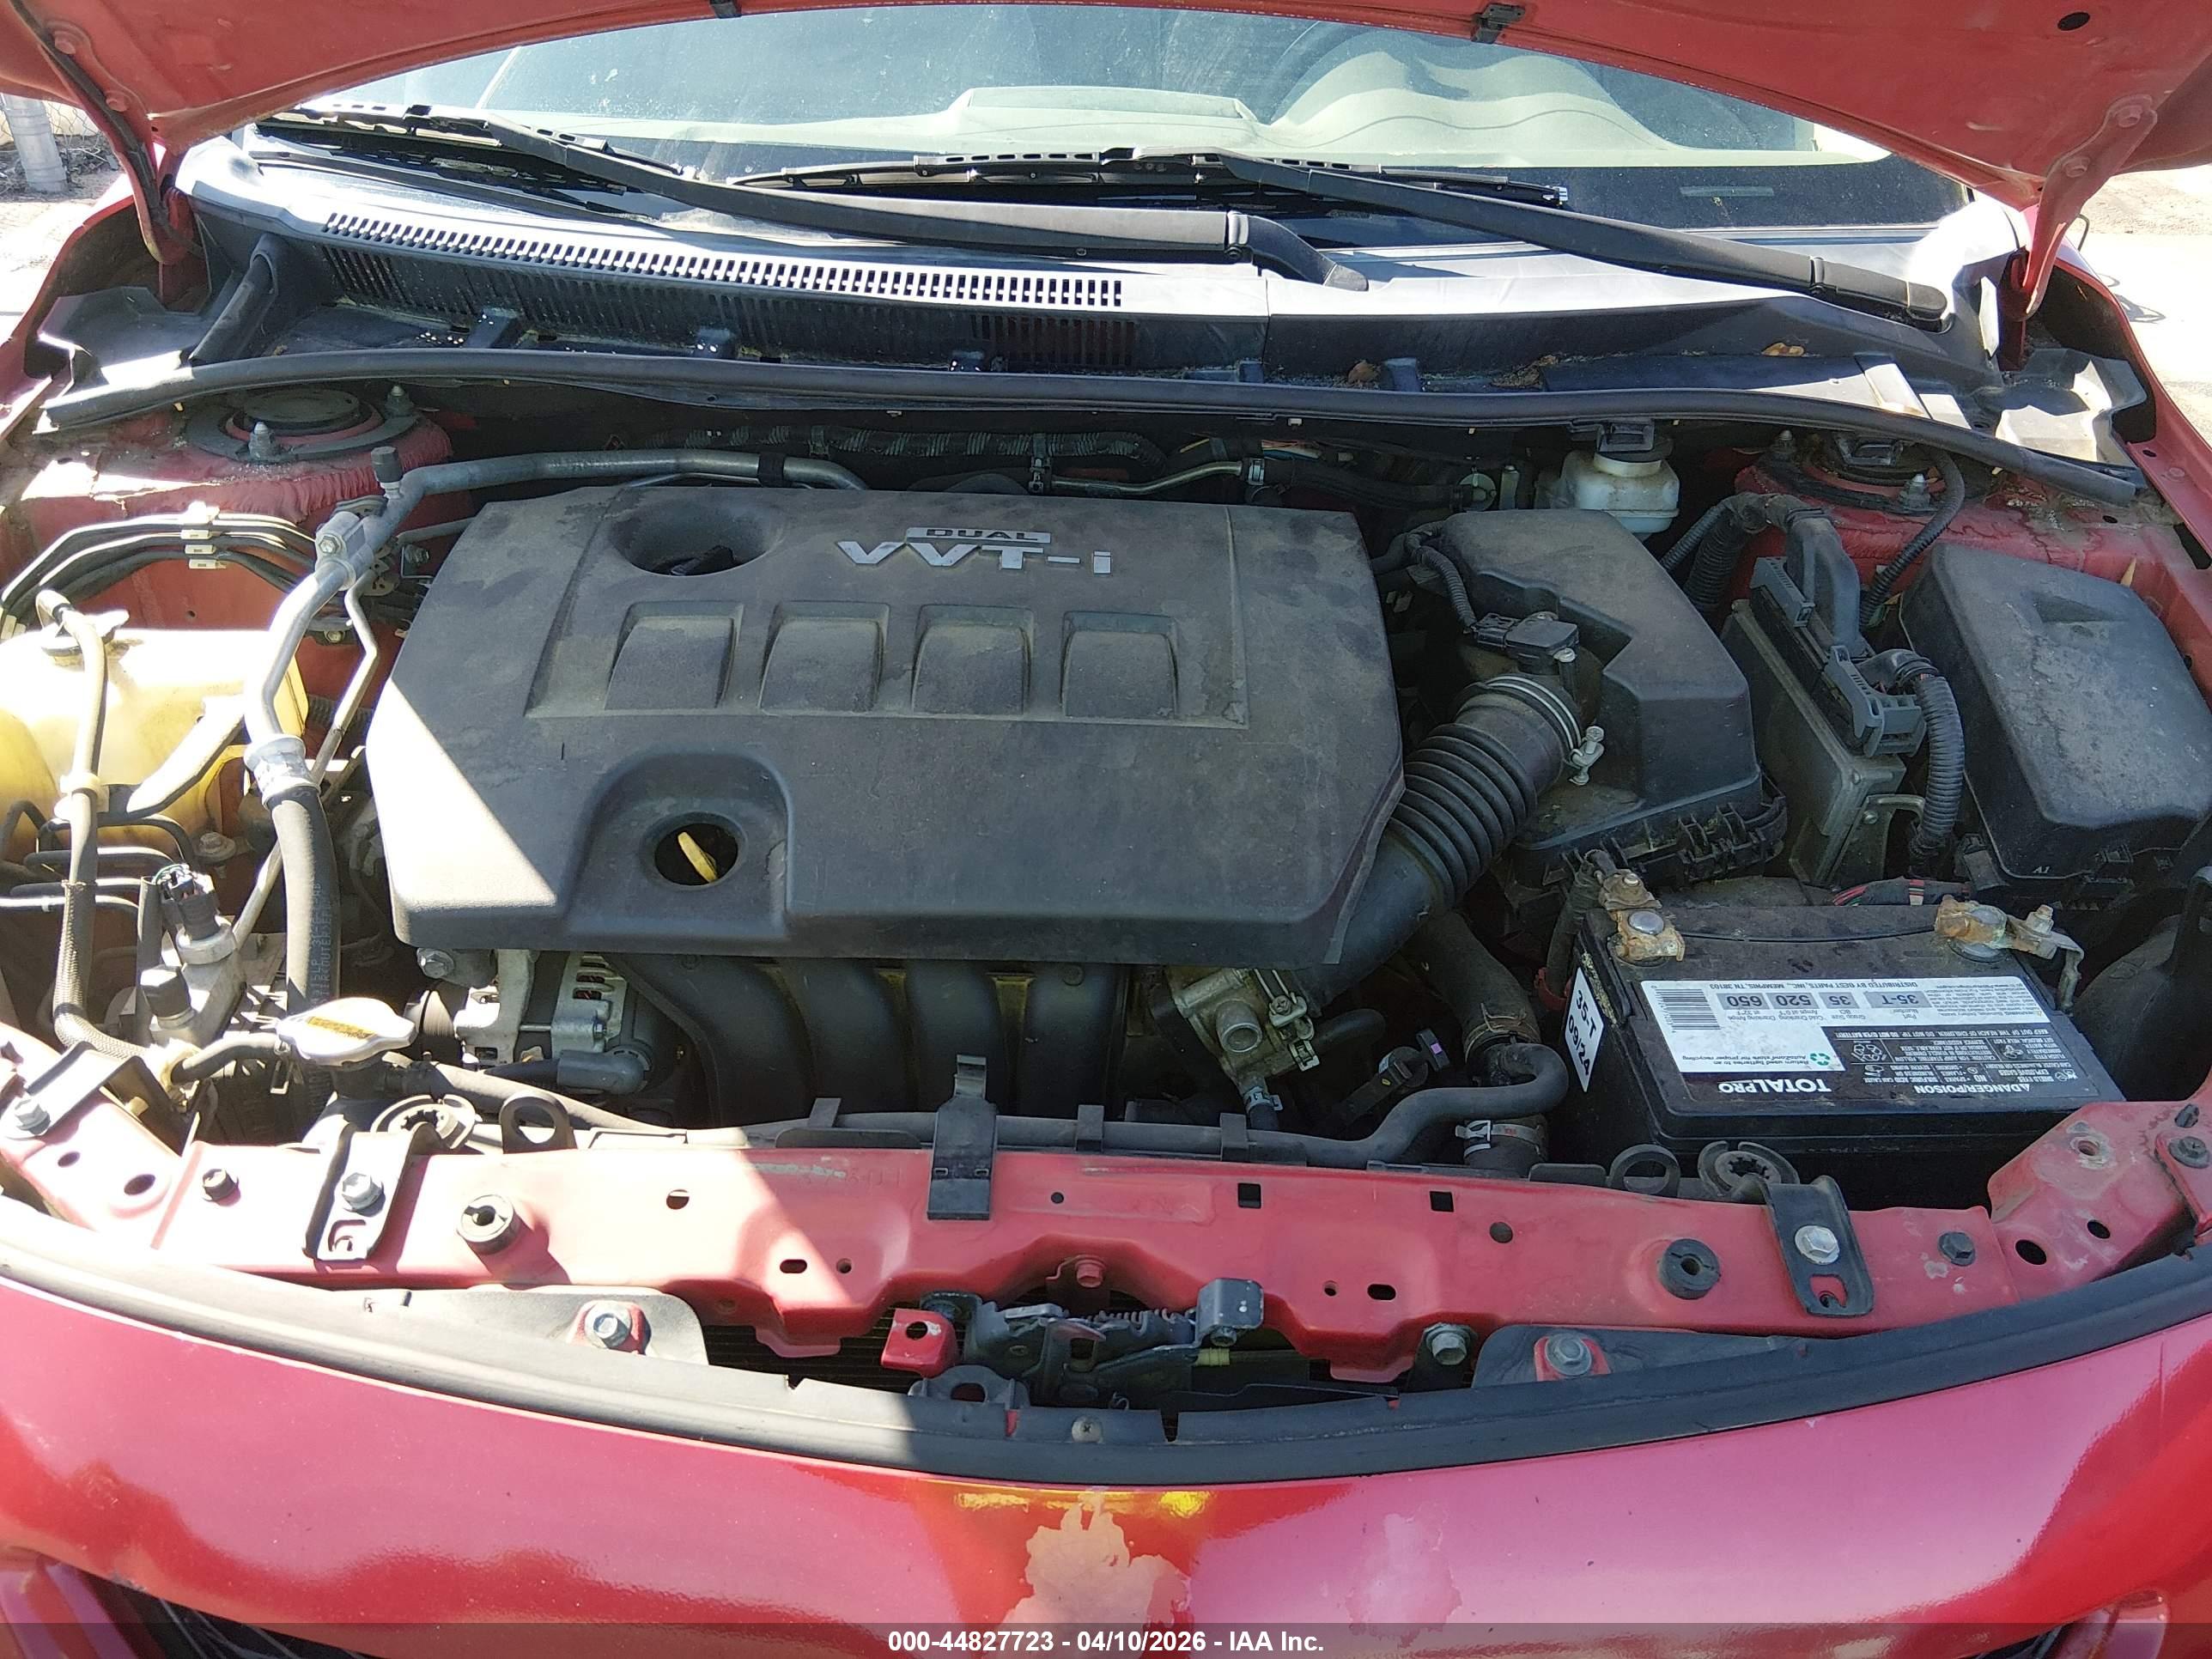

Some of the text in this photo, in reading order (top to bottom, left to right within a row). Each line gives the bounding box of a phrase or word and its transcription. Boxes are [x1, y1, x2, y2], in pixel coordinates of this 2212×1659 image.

[927, 528, 1038, 542] DUAL
[836, 541, 1111, 574] VVT-i
[1726, 995, 1762, 1006] 650
[1775, 995, 1811, 1006] 520
[1828, 995, 1850, 1006] 35
[1881, 994, 1919, 1005] 35-T
[1576, 989, 1597, 1039] 35-T
[1568, 1015, 1591, 1076] 09/24
[1717, 1079, 1832, 1093] TOTALPRO
[1913, 1084, 2021, 1093] DANGER/POISON
